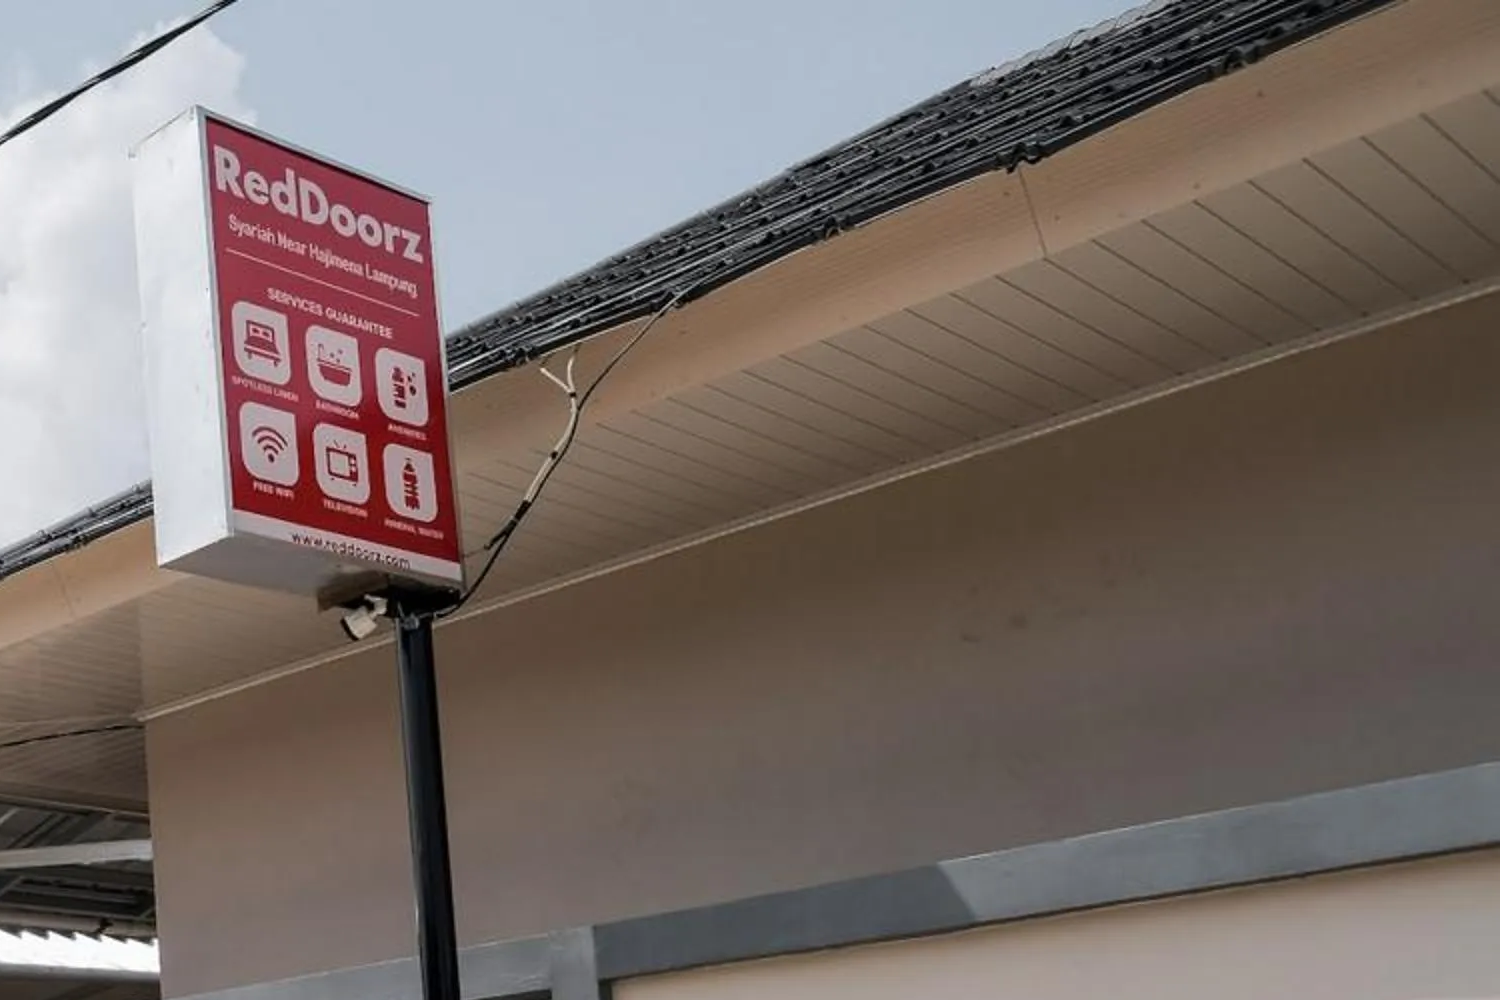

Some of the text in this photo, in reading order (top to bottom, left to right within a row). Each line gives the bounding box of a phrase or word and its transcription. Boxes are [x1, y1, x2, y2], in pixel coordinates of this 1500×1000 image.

[213, 144, 424, 264] RedDoorz
[227, 213, 418, 299] Syariah Near Hajimena Lampung
[325, 306, 393, 339] GUARANTEE
[253, 481, 274, 495] FREE
[291, 532, 411, 571] www.reddoorz.com
